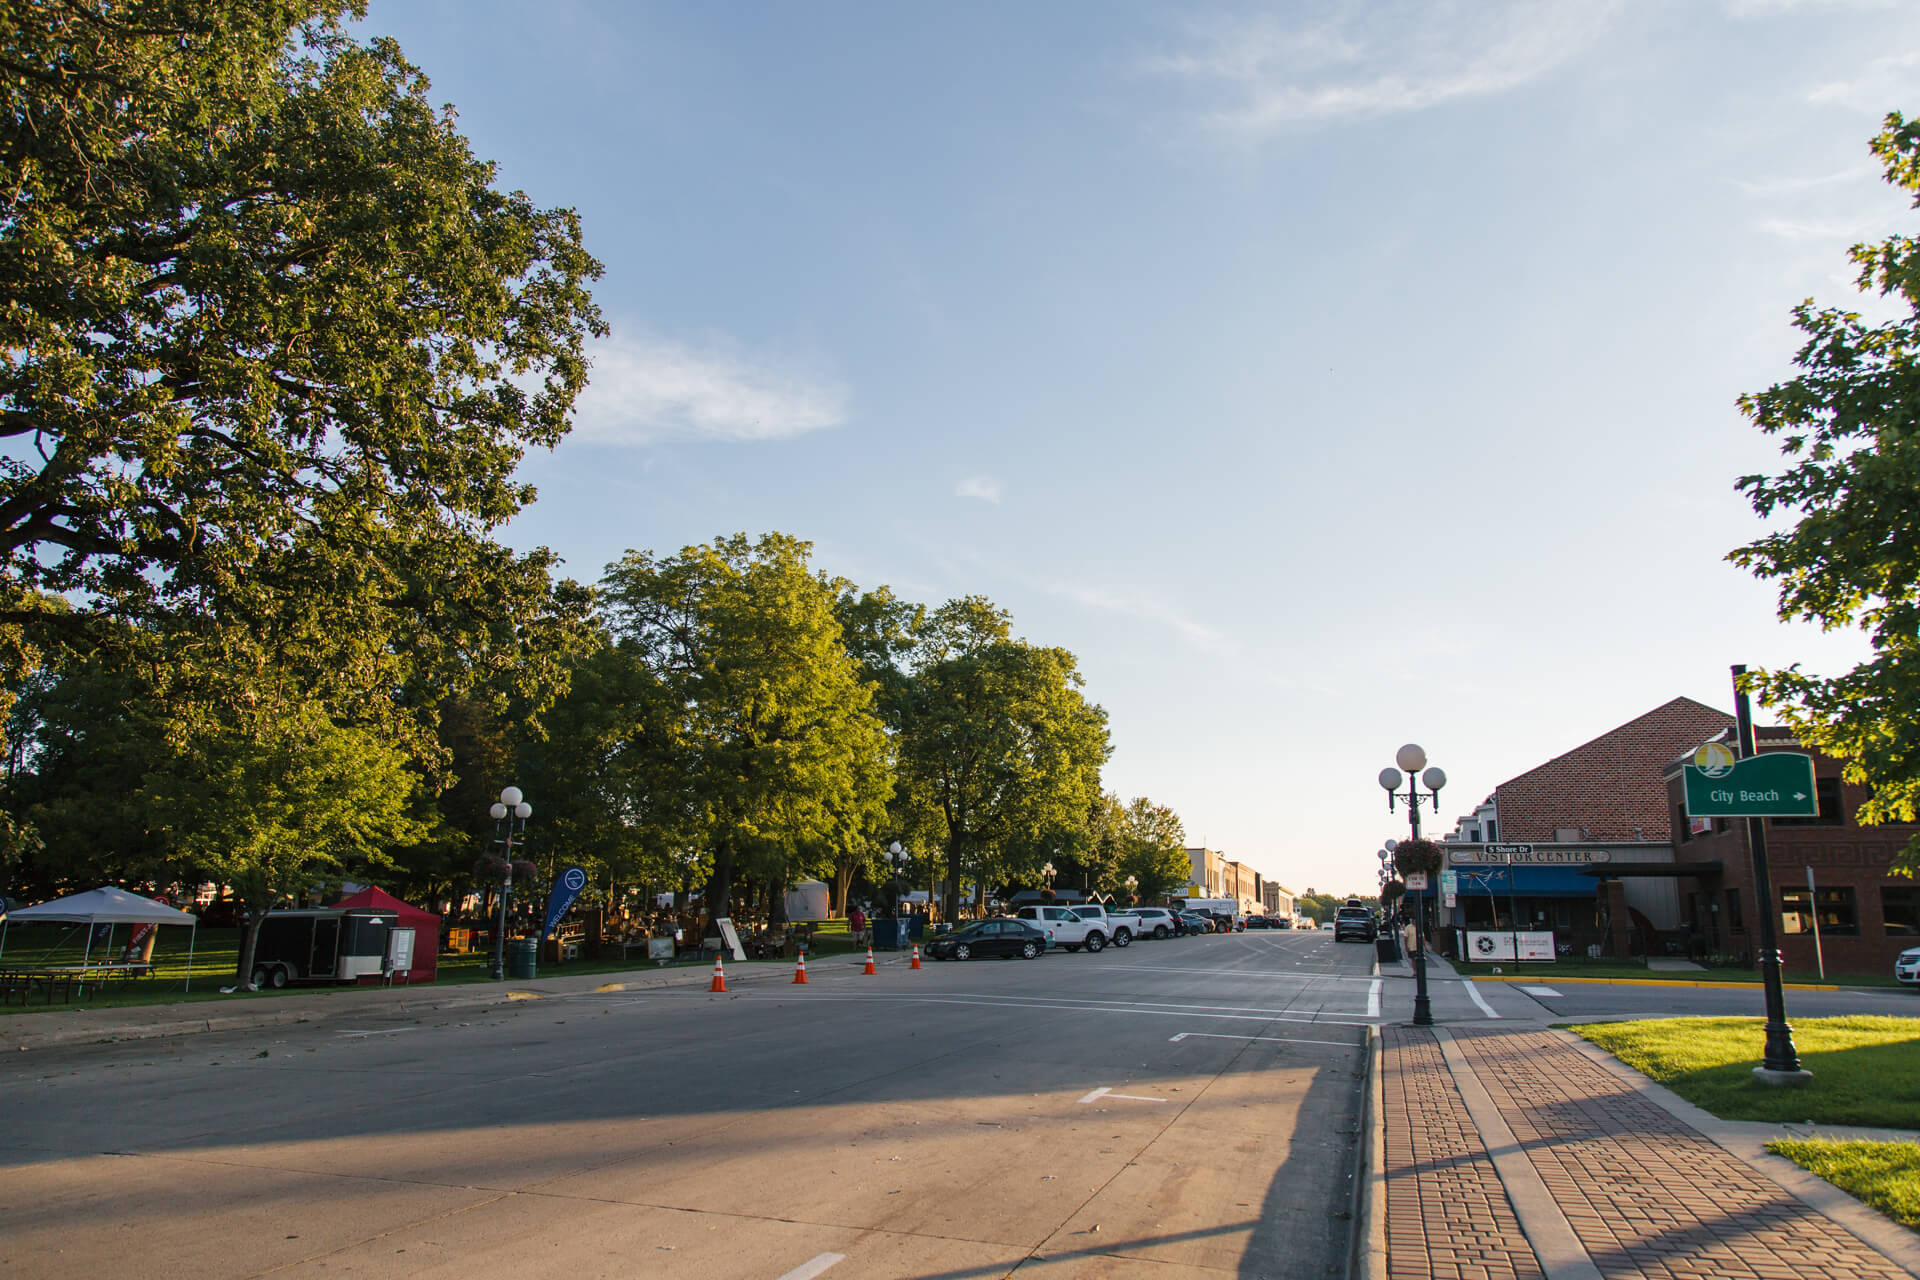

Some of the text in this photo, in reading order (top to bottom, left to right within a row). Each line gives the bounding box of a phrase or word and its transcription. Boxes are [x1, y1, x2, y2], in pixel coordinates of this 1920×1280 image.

[1710, 789, 1779, 805] City Beach
[1476, 851, 1533, 862] VISIOR
[1536, 851, 1593, 862] CENTER
[549, 894, 576, 928] WELCOME
